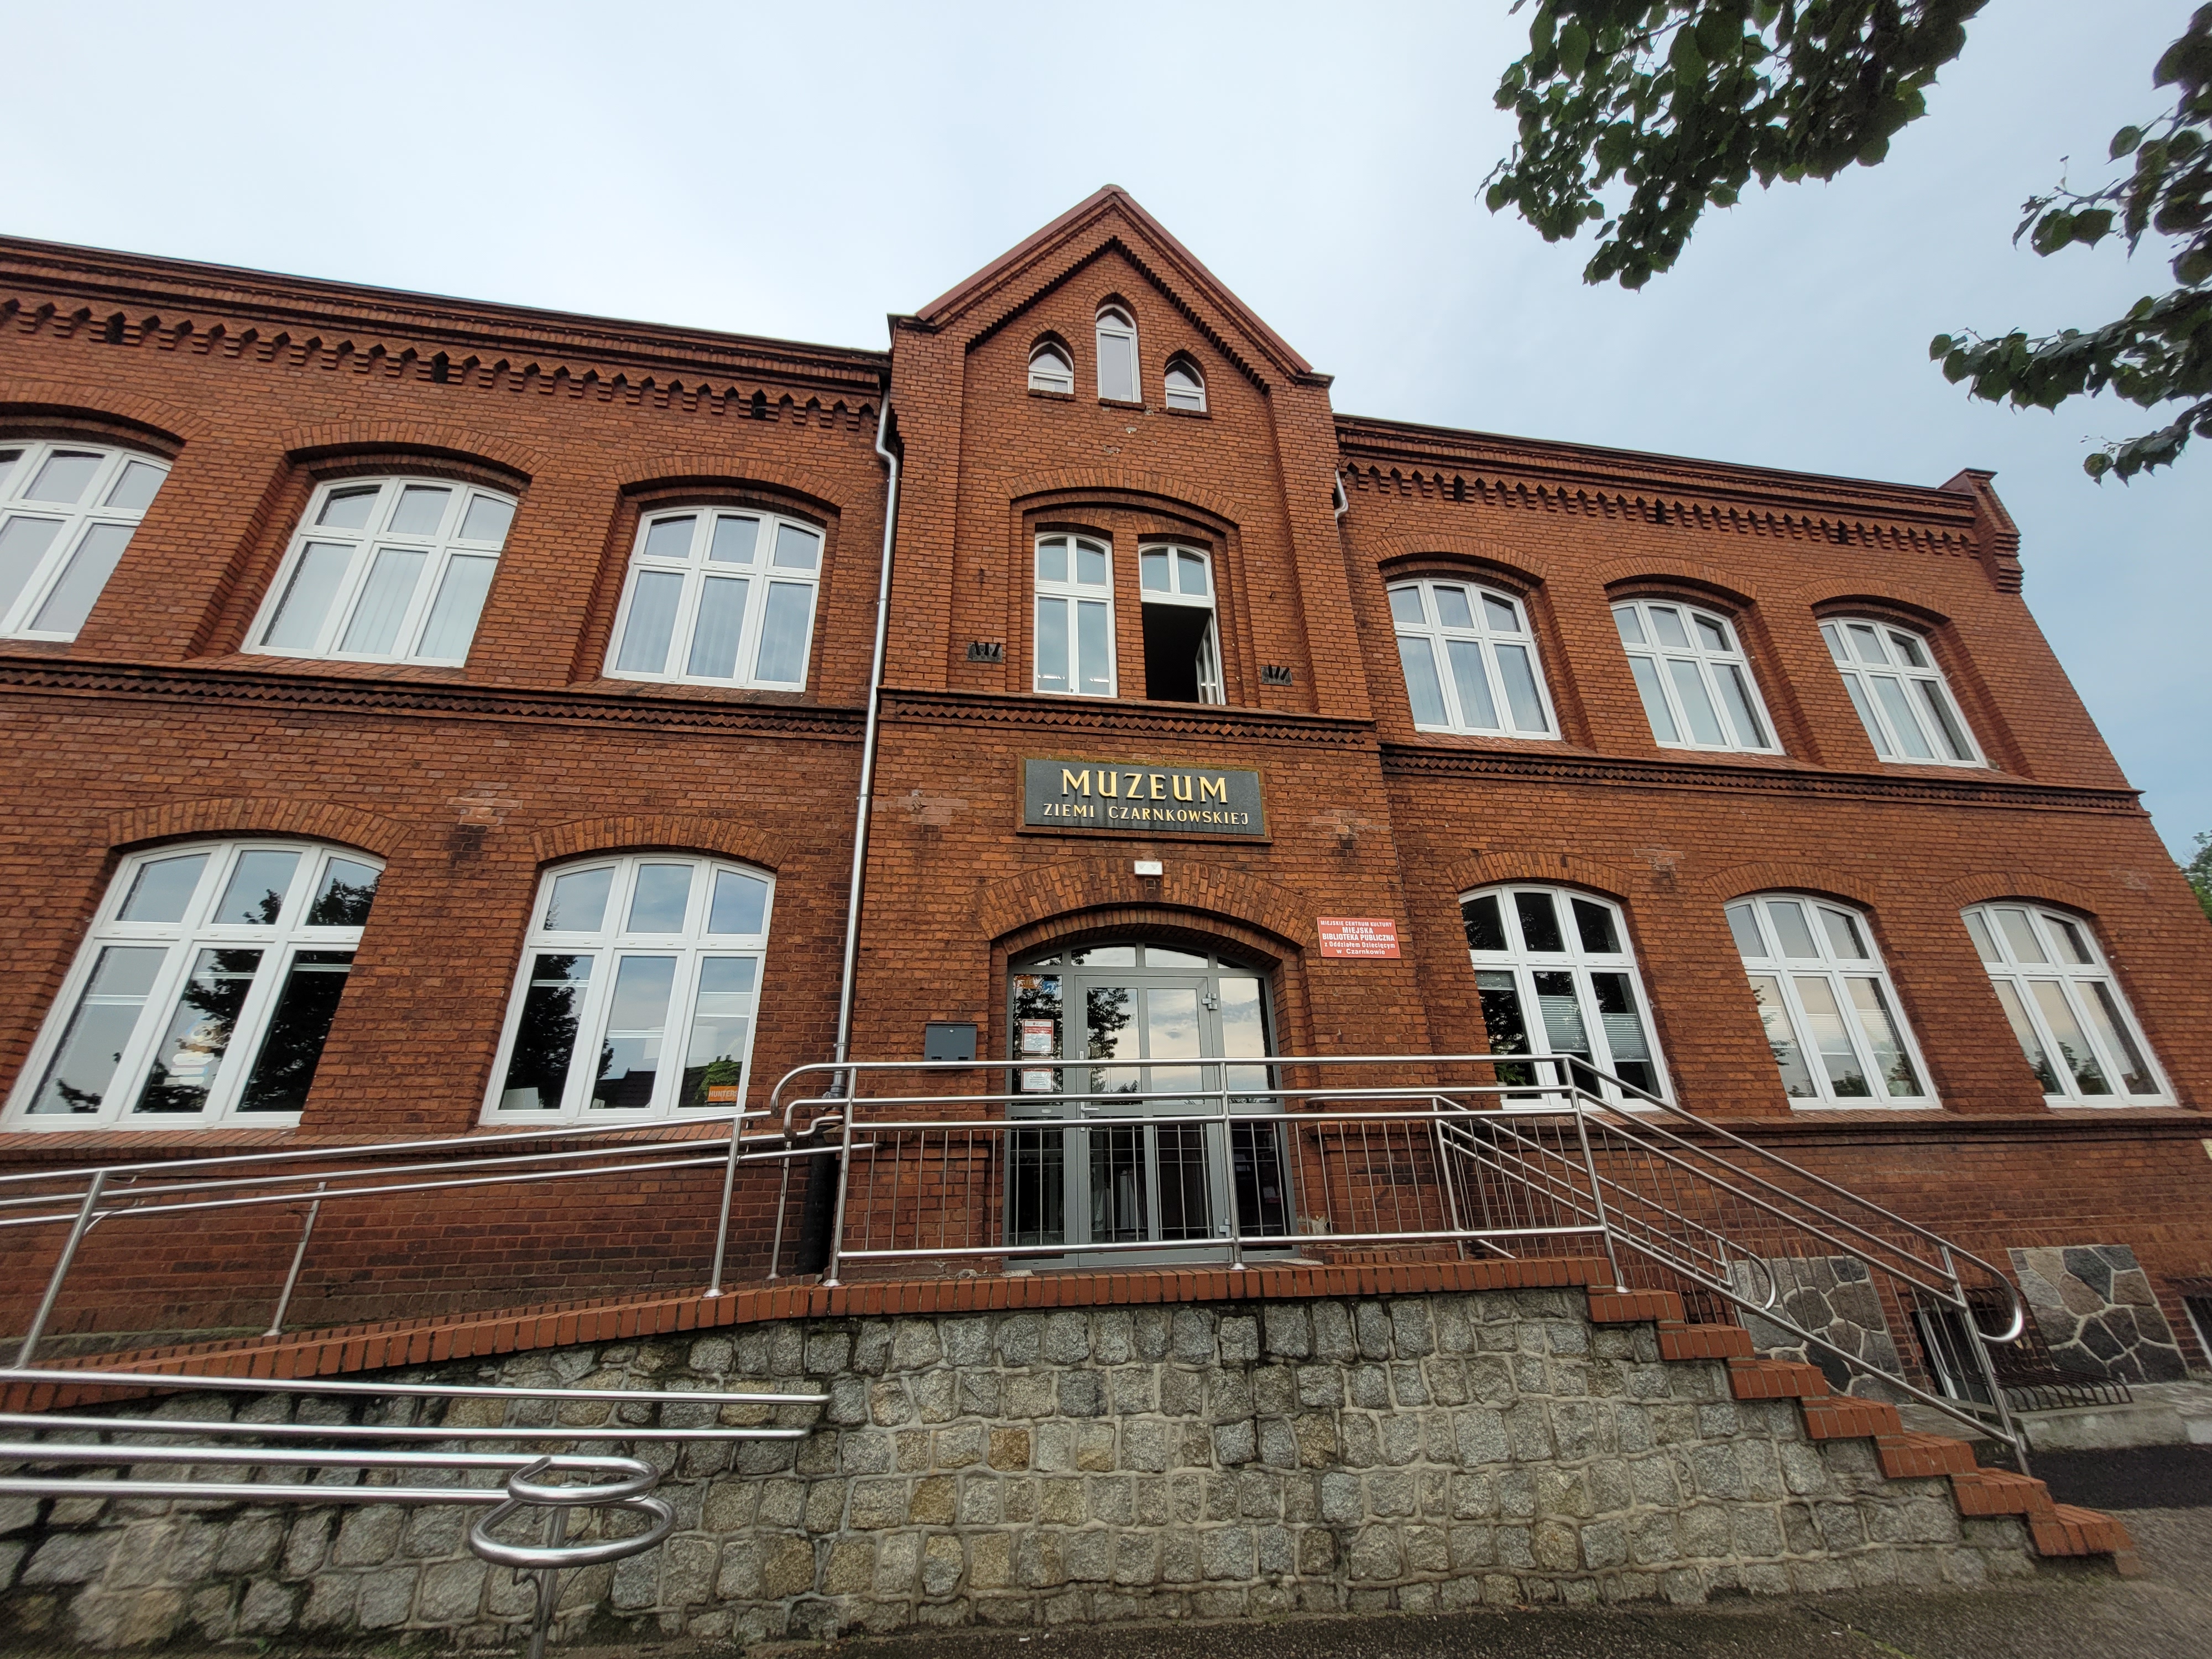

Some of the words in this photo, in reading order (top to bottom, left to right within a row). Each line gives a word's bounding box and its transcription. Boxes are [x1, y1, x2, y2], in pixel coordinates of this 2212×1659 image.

[1061, 769, 1228, 804] MUZEUM
[1043, 804, 1094, 818] ZIEMI
[1108, 806, 1249, 825] CZARNKOWSKIEJ
